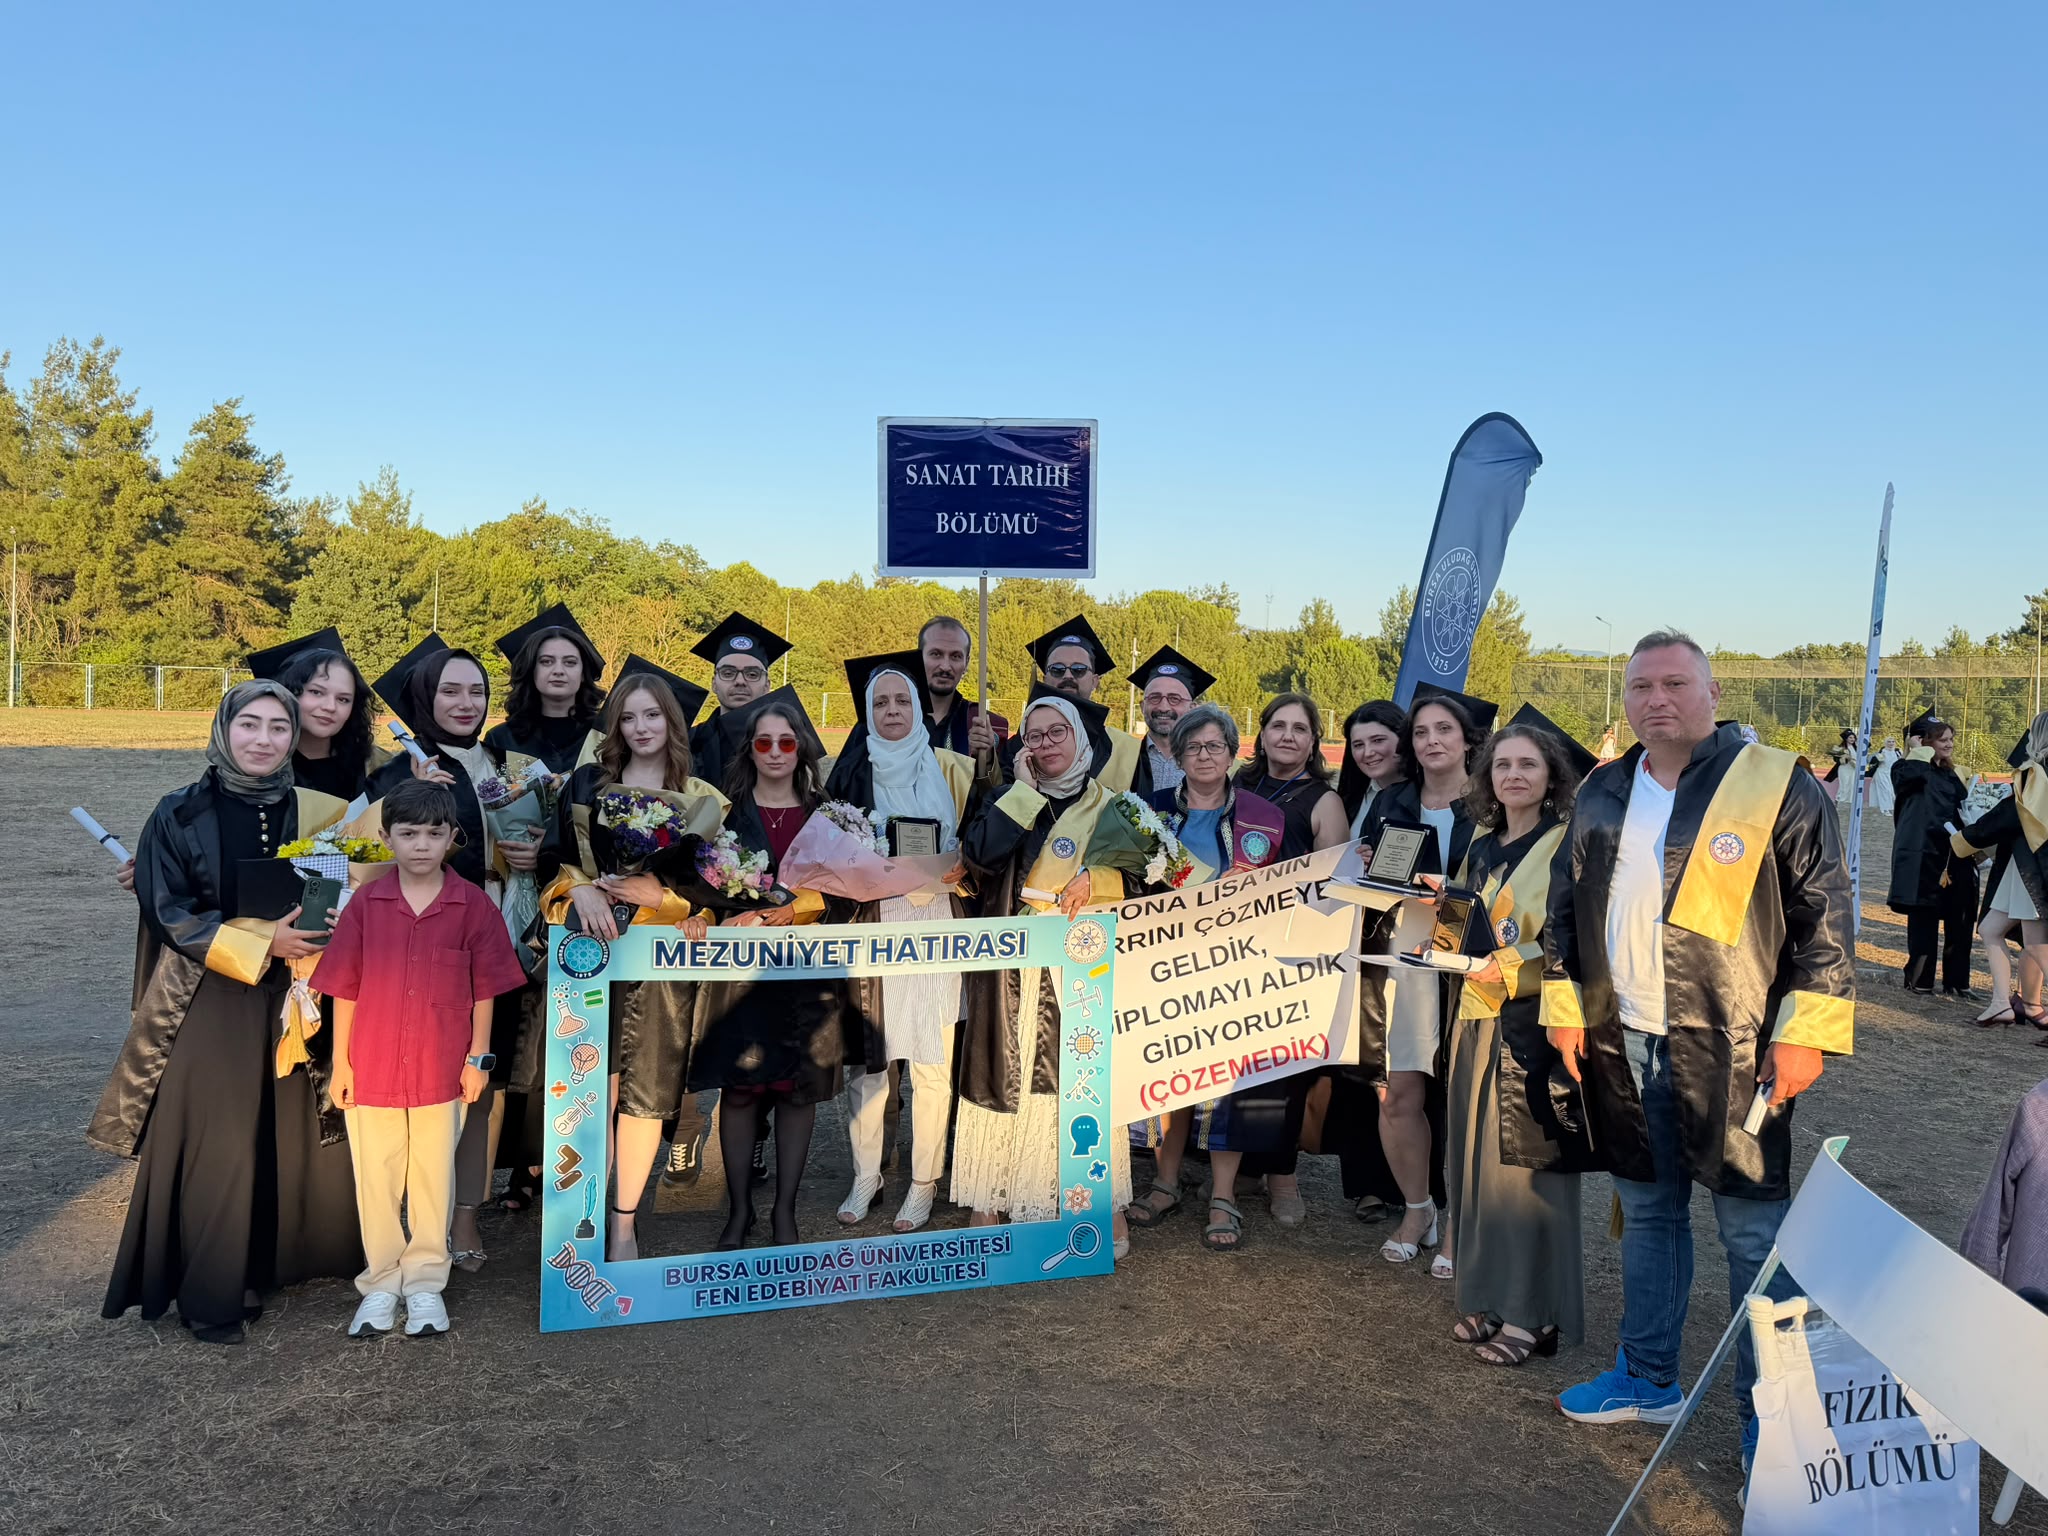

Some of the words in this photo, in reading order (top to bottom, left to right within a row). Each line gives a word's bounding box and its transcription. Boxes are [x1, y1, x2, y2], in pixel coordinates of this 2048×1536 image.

[906, 464, 981, 486] SANAT
[987, 463, 1070, 487] TARİHİ
[935, 511, 1039, 535] BÖLÜMÜ
[1425, 572, 1441, 617] BURSA
[1441, 551, 1471, 572] ULUDAĞ
[1430, 651, 1449, 672] 1975
[655, 933, 861, 968] MEZUNİYET
[869, 930, 1027, 965] HATIRASI
[1150, 935, 1268, 983] GELDİK,
[1112, 977, 1252, 1035] İPLOMAYI
[1260, 952, 1347, 994] ALDIK
[1143, 999, 1311, 1064] GİDİYORUZ!
[1139, 1032, 1331, 1112] (ÇÖZEMEDİK)
[665, 1262, 750, 1286] BURSA
[756, 1247, 856, 1277] ULUDAĞ
[860, 1231, 1011, 1267] ÜNİVERSİTESİ
[695, 1286, 744, 1308] FEN
[750, 1273, 862, 1303] EDEBİYAT
[867, 1260, 987, 1290] FAKÜLTESİ
[1822, 1373, 1922, 1429] FİZİK
[1803, 1433, 1958, 1505] BÖLÜMÜ
